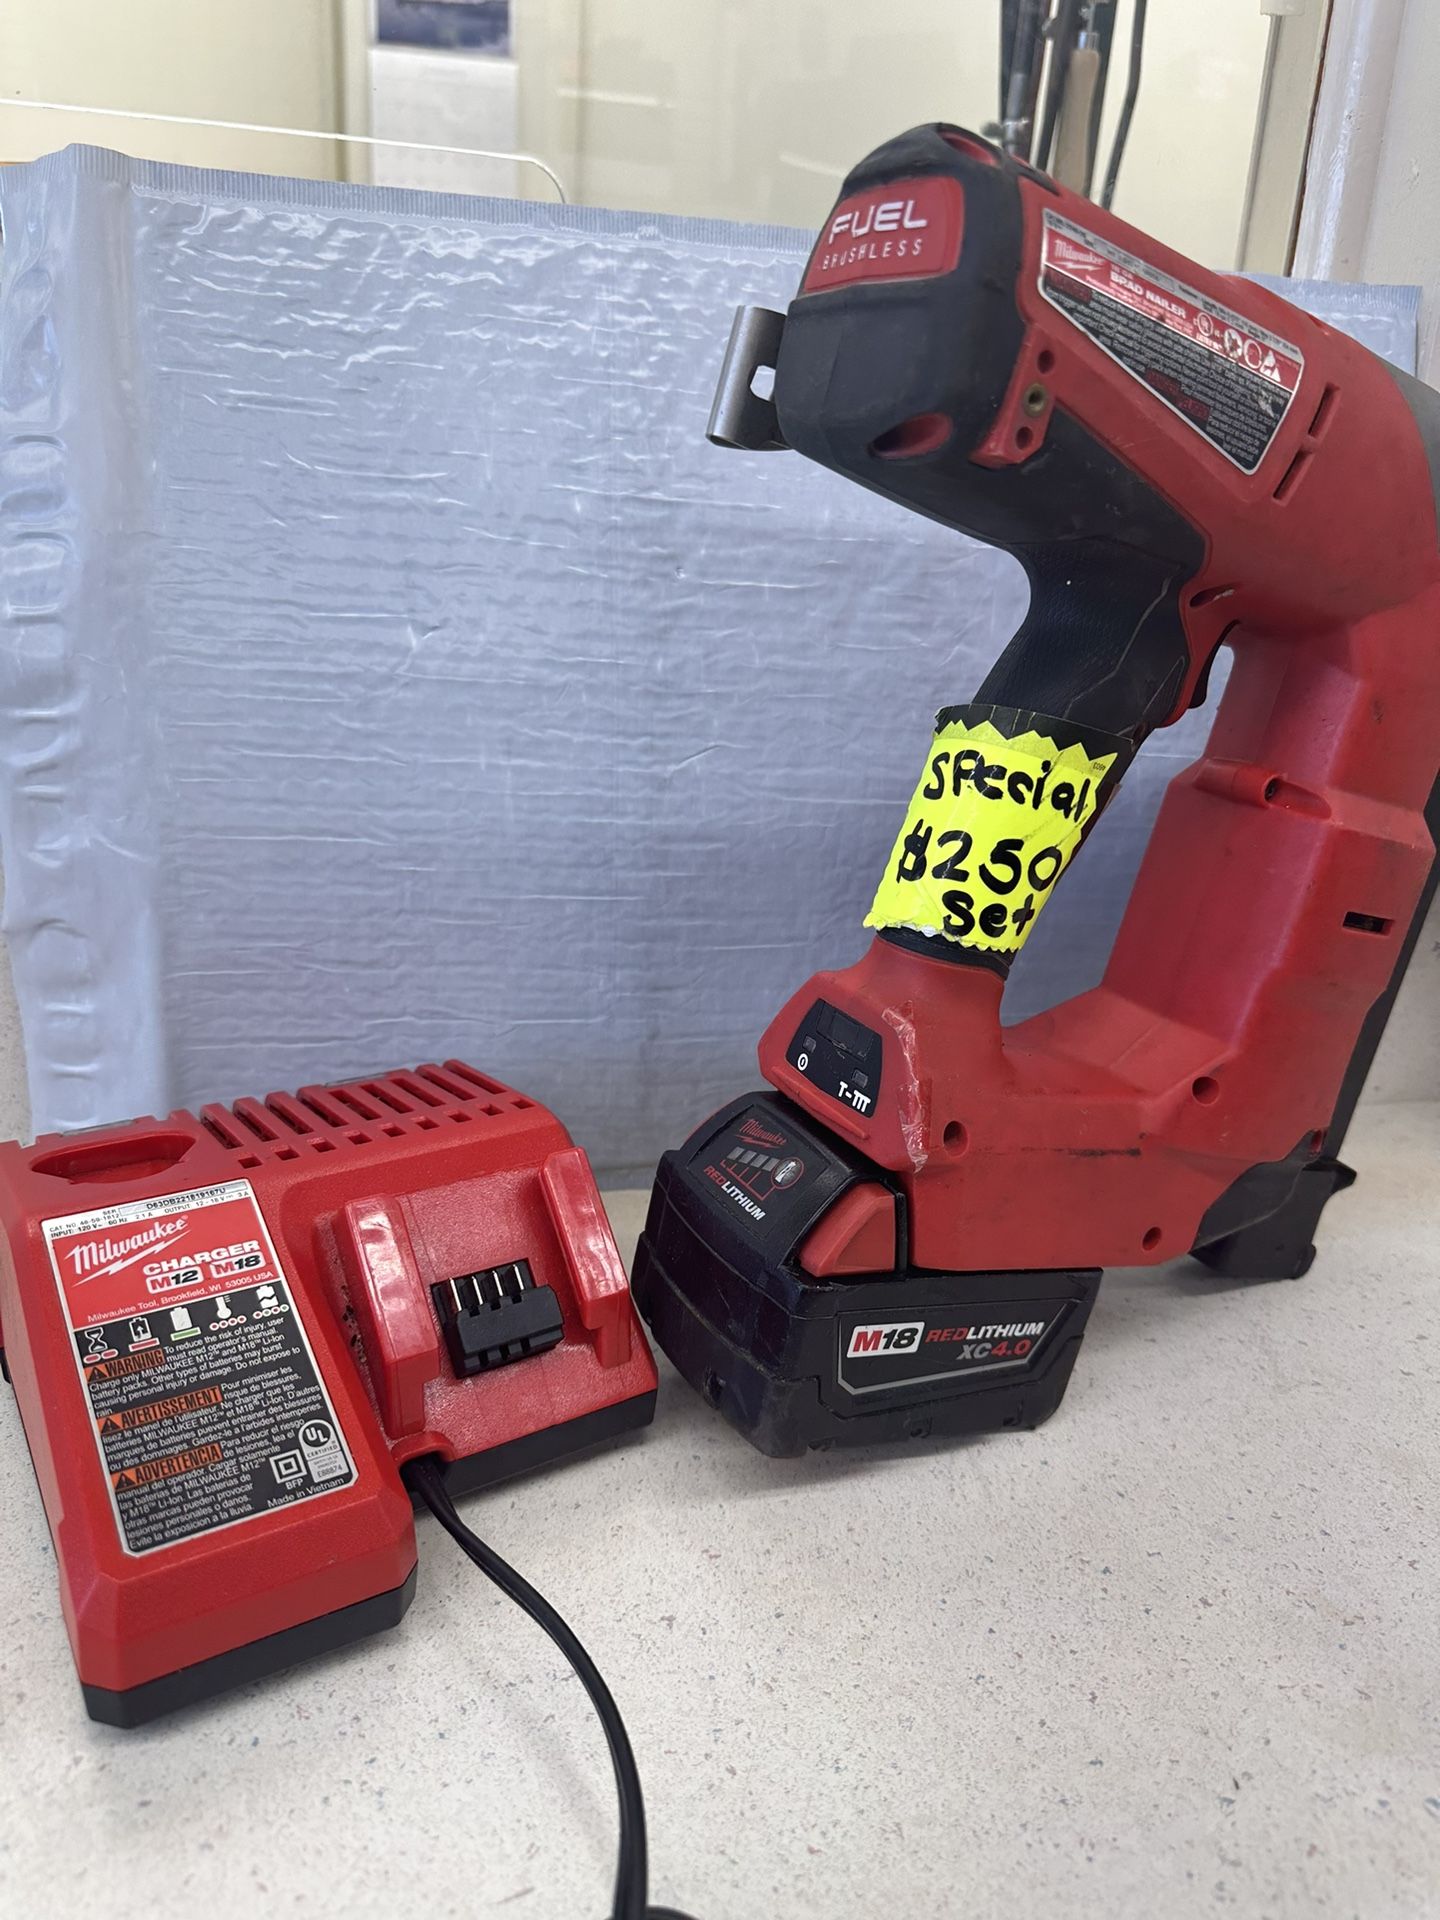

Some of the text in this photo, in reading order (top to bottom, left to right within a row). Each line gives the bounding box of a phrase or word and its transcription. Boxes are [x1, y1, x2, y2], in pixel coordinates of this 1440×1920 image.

[829, 199, 928, 244] FUEL
[822, 239, 923, 270] BRUSHLESS
[1054, 239, 1105, 265] Milwaukee
[1109, 270, 1144, 296] BRAD
[1145, 290, 1187, 319] NAILER
[896, 818, 1063, 895] $250
[942, 889, 1035, 938] Set
[739, 1118, 788, 1145] Milwaukee
[703, 1165, 767, 1221] REDLITHIUM
[64, 1217, 187, 1277] Milwaukee
[141, 1239, 261, 1276] CHARGER
[148, 1254, 263, 1291] M12 M18
[86, 1270, 274, 1322] Milwaukee Tool, Brookfield, WI 53005 USA
[163, 1345, 174, 1353] To
[174, 1337, 203, 1350] reduce
[203, 1333, 217, 1343] the
[217, 1329, 233, 1339] risk
[233, 1327, 243, 1335] of
[266, 1317, 285, 1326] user
[165, 1350, 187, 1362] must
[187, 1345, 206, 1356] read
[206, 1334, 247, 1352] operator's
[852, 1327, 920, 1353] M18
[925, 1321, 1045, 1344] REDLITHIUM
[956, 1339, 1033, 1361] XC4.0
[88, 1376, 121, 1393] Charge
[121, 1371, 140, 1384] only
[140, 1356, 195, 1377] MILWAUKEE
[220, 1345, 237, 1356] and
[261, 1332, 285, 1344] Li-Ion
[90, 1385, 121, 1402] battery
[150, 1371, 174, 1384] Other
[175, 1364, 198, 1379] types
[198, 1361, 208, 1371] of
[208, 1352, 243, 1368] batteries
[243, 1348, 262, 1360] may
[261, 1341, 282, 1353] burst
[93, 1393, 127, 1411] causing
[127, 1383, 165, 1401] personal
[164, 1376, 188, 1391] injury
[234, 1360, 248, 1369] Do
[247, 1356, 262, 1366] not
[262, 1349, 292, 1364] expose
[290, 1345, 301, 1354] to
[104, 1349, 164, 1377] WARNING
[220, 1364, 292, 1391] Pour minimiser les
[118, 1386, 222, 1428] AVERTISSEMENT
[222, 1386, 249, 1401] risque
[248, 1382, 261, 1392] de
[102, 1431, 122, 1444] lisez
[123, 1428, 132, 1438] le
[133, 1420, 161, 1435] manel
[161, 1417, 173, 1427] de
[219, 1399, 233, 1409] Ne
[233, 1390, 266, 1407] charger
[265, 1387, 282, 1398] que
[281, 1381, 295, 1391] les
[104, 1435, 142, 1453] batteries
[142, 1418, 198, 1442] MILWAUKEE
[224, 1407, 235, 1417] et
[286, 1383, 320, 1399] D'autres
[107, 1445, 146, 1464] marques
[145, 1440, 158, 1450] de
[158, 1429, 196, 1446] batteries
[266, 1403, 283, 1414] des
[283, 1391, 322, 1409] blessures
[219, 1417, 306, 1449] Para reducir el riesgo
[222, 1448, 234, 1458] de
[271, 1432, 286, 1442] lea
[285, 1429, 295, 1438] el
[304, 1423, 328, 1446] UL
[306, 1443, 338, 1458] CERTIFIED
[109, 1462, 121, 1472] ou
[122, 1455, 139, 1468] des
[116, 1484, 149, 1501] manual
[150, 1479, 165, 1490] del
[207, 1456, 237, 1473] Cargar
[237, 1443, 281, 1463] solamente
[132, 1443, 220, 1484] ADVERTENCIA
[118, 1464, 240, 1511] las baterias de MILWAUKEE
[121, 1513, 128, 1521] y
[186, 1487, 203, 1499] Las
[204, 1475, 239, 1493] baterias
[238, 1471, 251, 1482] de
[266, 1474, 345, 1508] Made in Vietnam
[284, 1476, 305, 1490] BFP
[124, 1482, 254, 1530] otras marcas pueden provocar
[126, 1520, 163, 1539] lesiones
[164, 1503, 213, 1528] personales
[128, 1533, 153, 1549] Evite
[153, 1530, 163, 1541] la
[163, 1514, 210, 1539] exposicion
[218, 1508, 229, 1519] la
